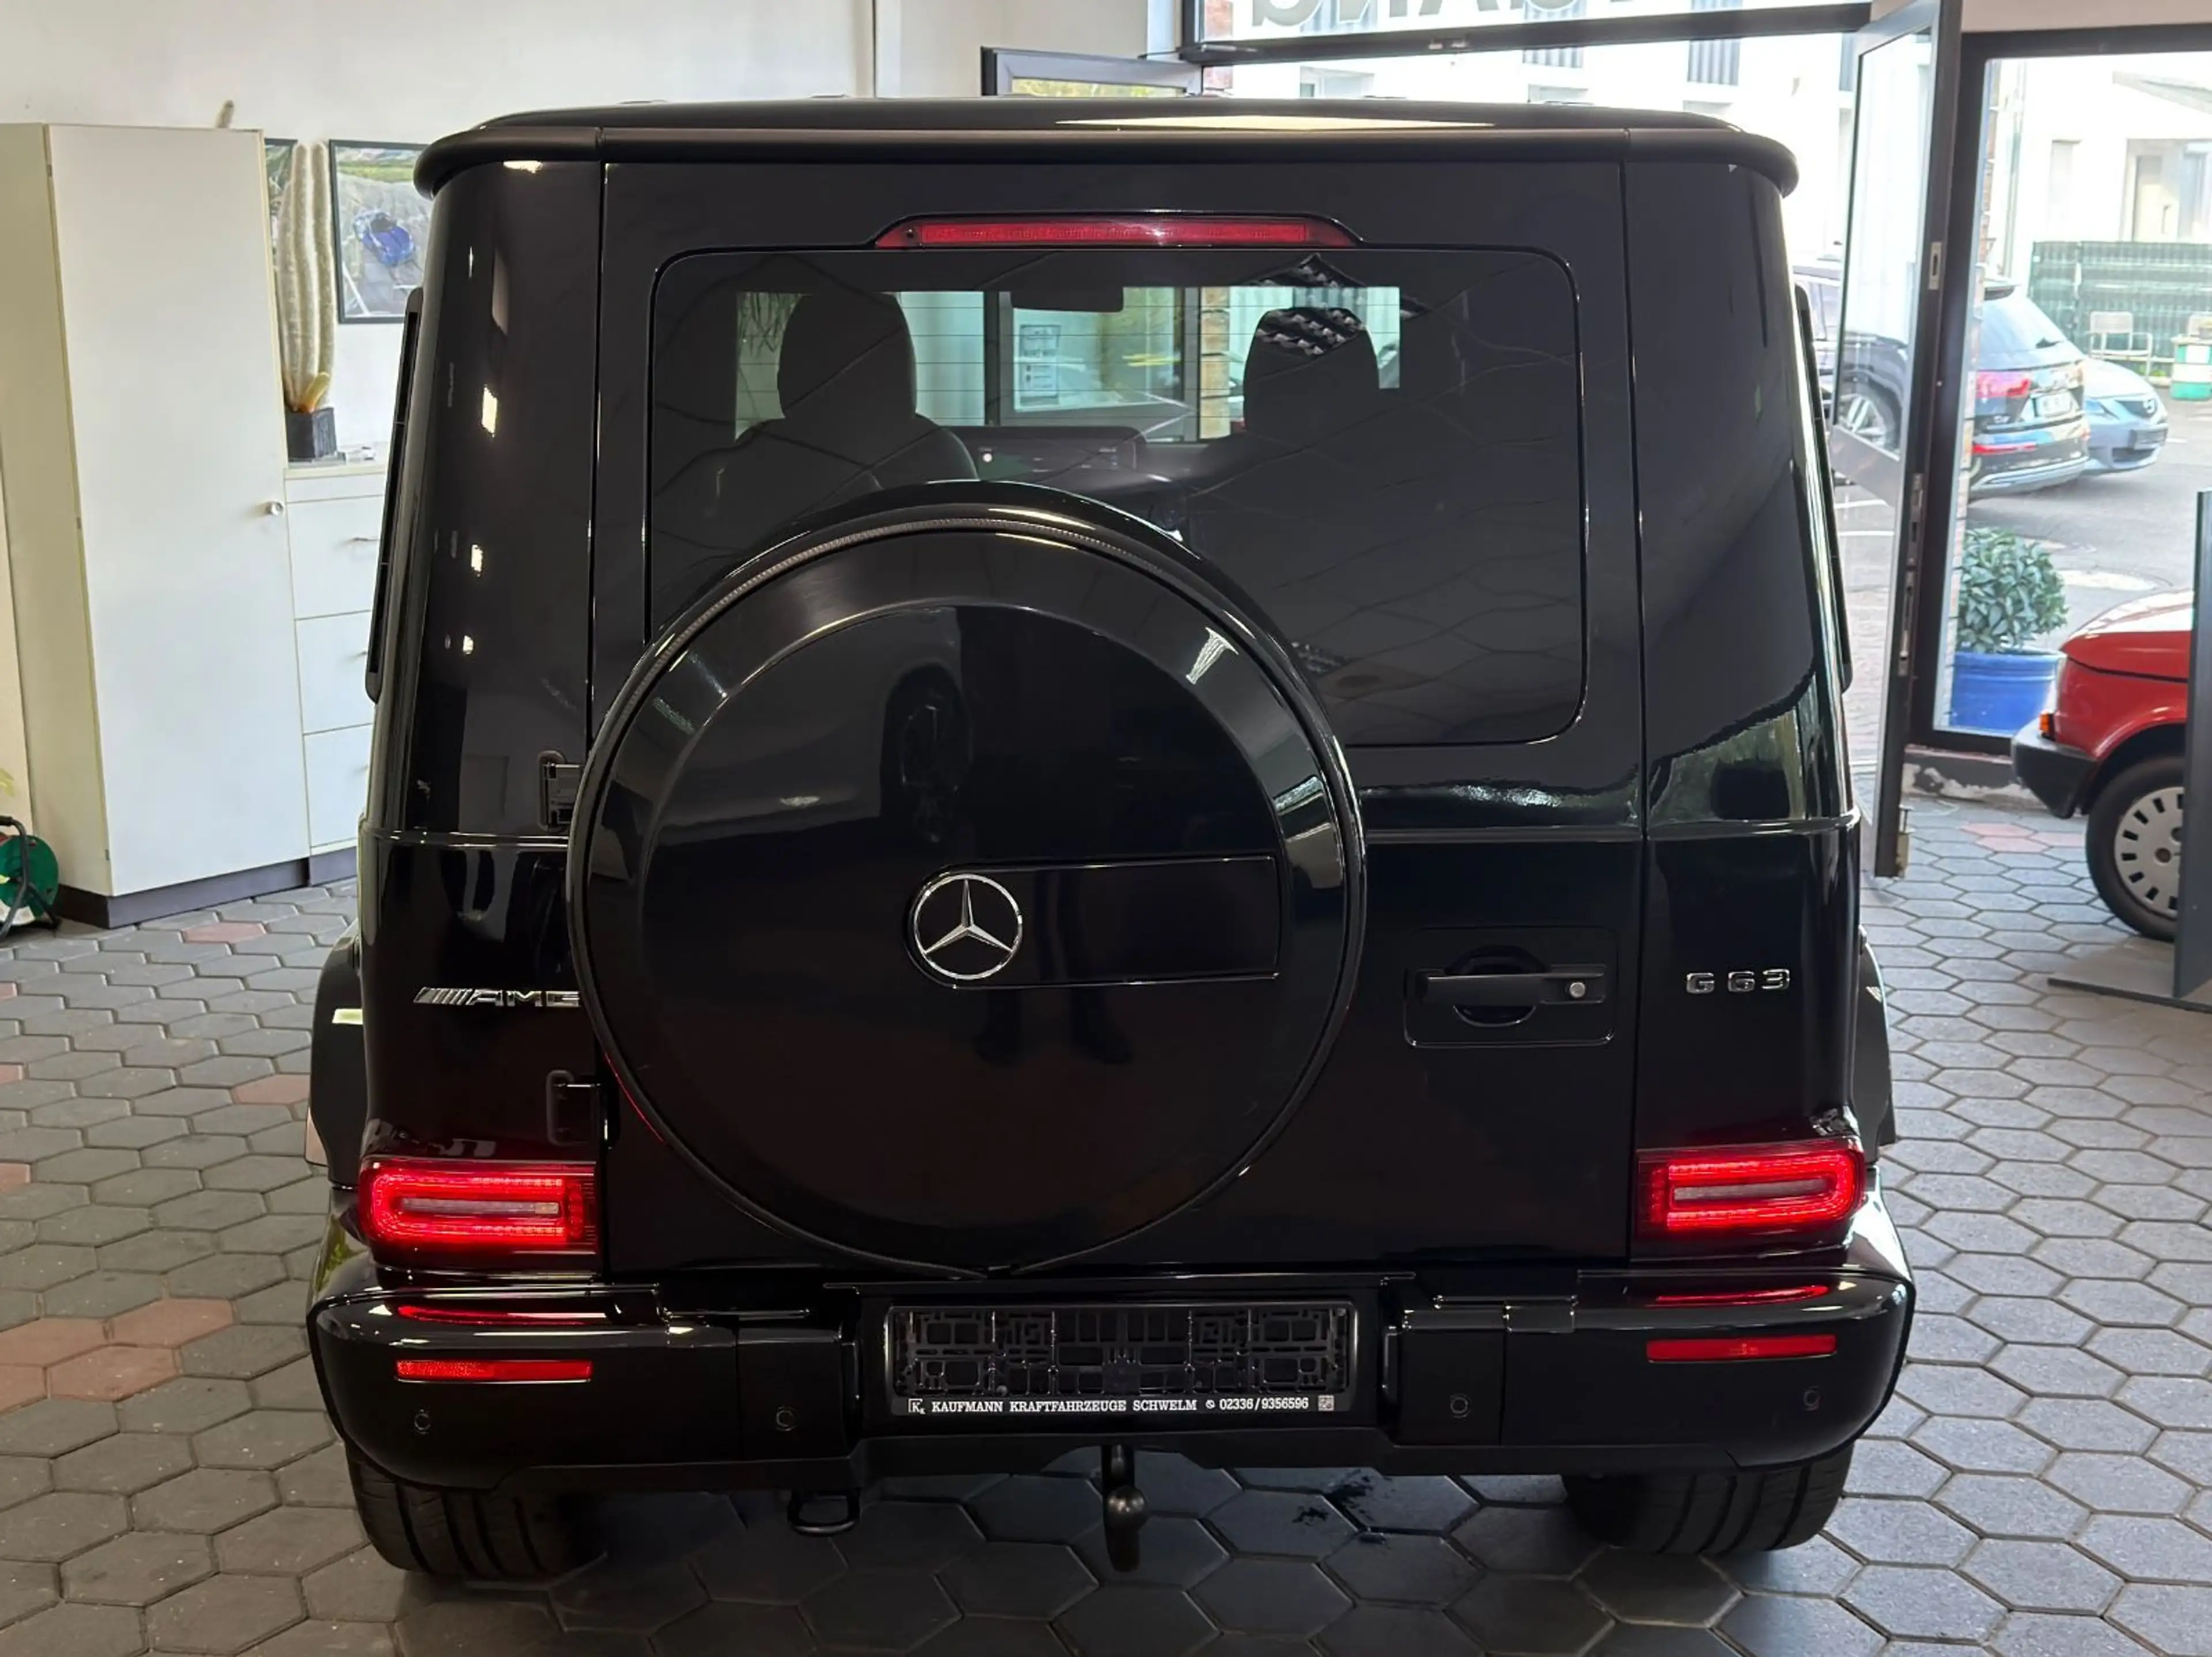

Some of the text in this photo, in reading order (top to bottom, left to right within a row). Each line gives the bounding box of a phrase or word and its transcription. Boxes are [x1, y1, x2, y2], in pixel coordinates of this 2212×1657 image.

[1728, 969, 1790, 992] 63
[464, 988, 579, 1007] AMG
[931, 1401, 1003, 1412] KAUFMANN
[1010, 1400, 1127, 1412] KRAFTFAHRZEUGE
[1132, 1400, 1197, 1411] SCHWELM
